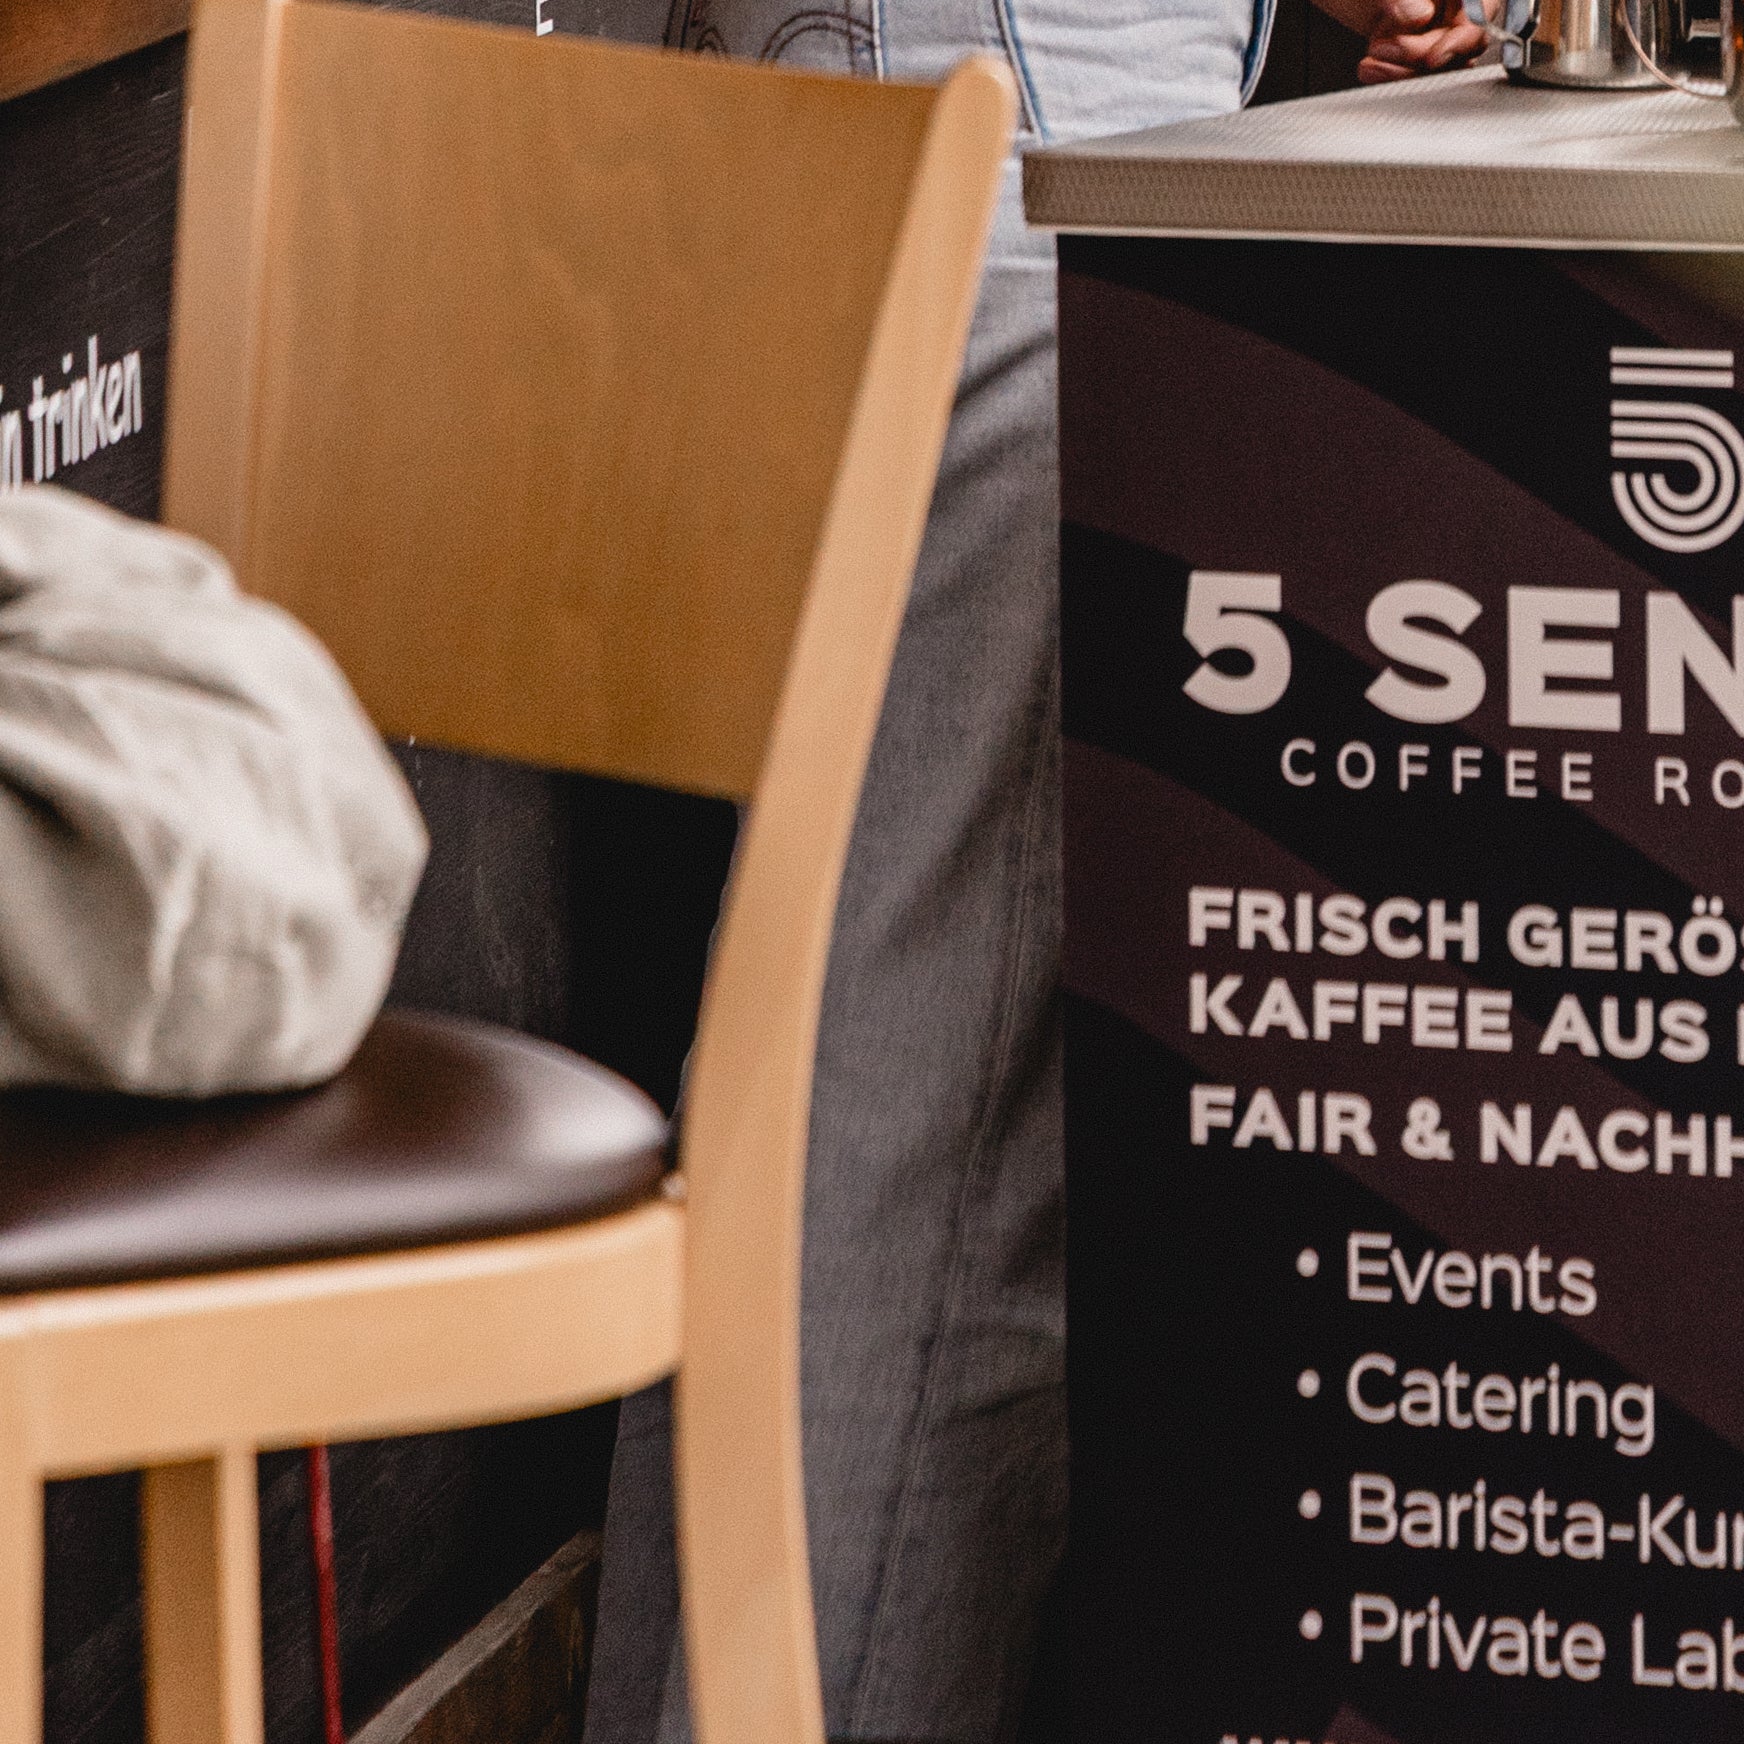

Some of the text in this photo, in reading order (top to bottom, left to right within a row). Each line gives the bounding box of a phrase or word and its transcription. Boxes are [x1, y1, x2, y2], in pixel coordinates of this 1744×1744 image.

[28, 334, 143, 483] trinken
[1184, 572, 1291, 713] 5
[1281, 739, 1593, 801] COFFEE
[1189, 887, 1479, 962] FRISCH
[1190, 974, 1513, 1052] KAFFEE
[1540, 995, 1709, 1062] AUS
[1191, 1086, 1376, 1155] FAIR
[1402, 1098, 1453, 1160] &
[1348, 1233, 1597, 1316] Events
[1348, 1354, 1654, 1456] Catering
[1352, 1595, 1605, 1680] Private
